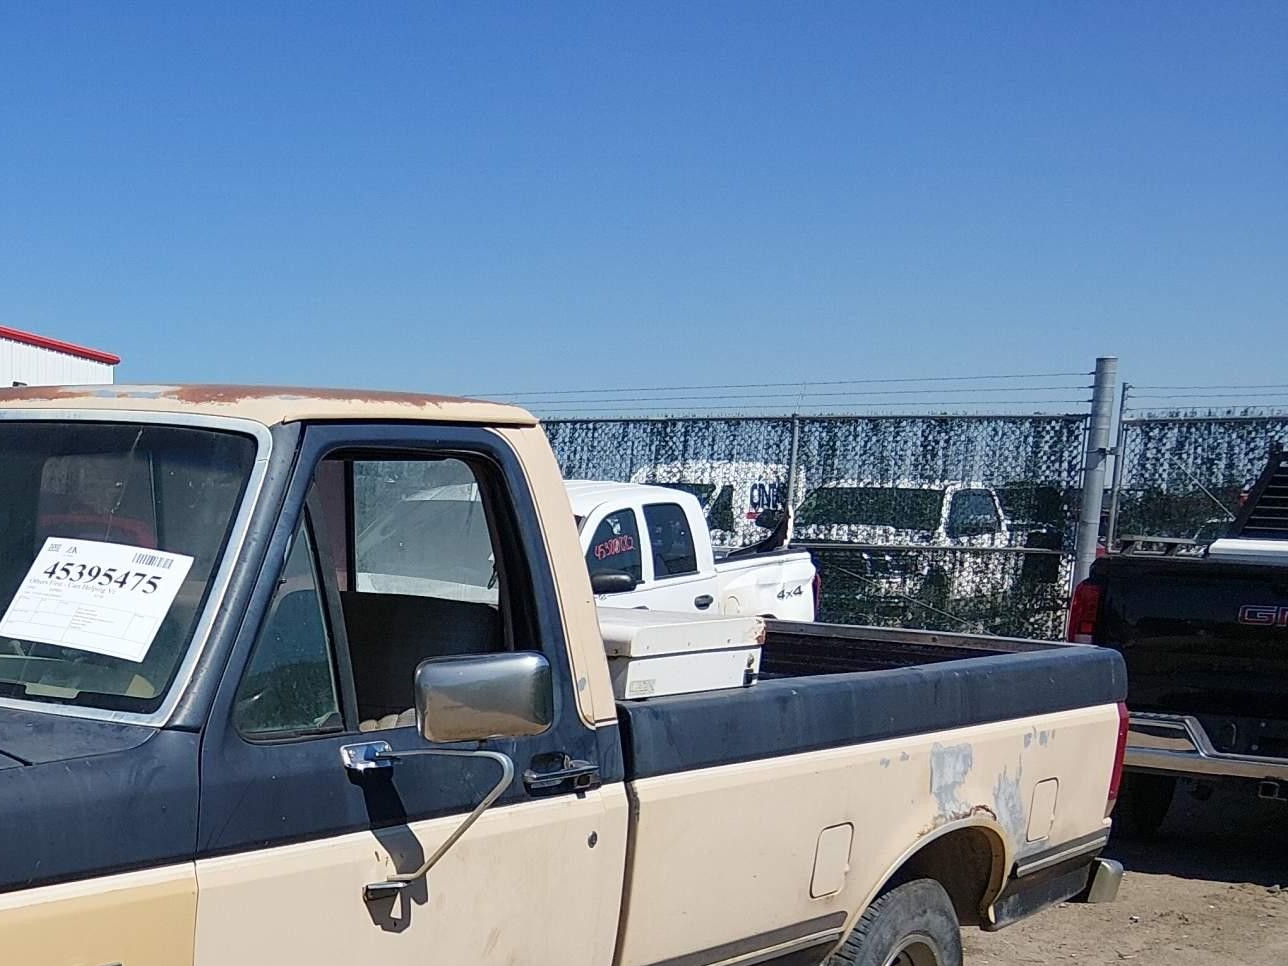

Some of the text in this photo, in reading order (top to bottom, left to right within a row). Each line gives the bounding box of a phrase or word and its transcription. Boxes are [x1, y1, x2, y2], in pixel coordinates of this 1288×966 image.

[43, 561, 163, 595] 45395475
[776, 584, 804, 601] 4x4
[1238, 603, 1288, 627] G
